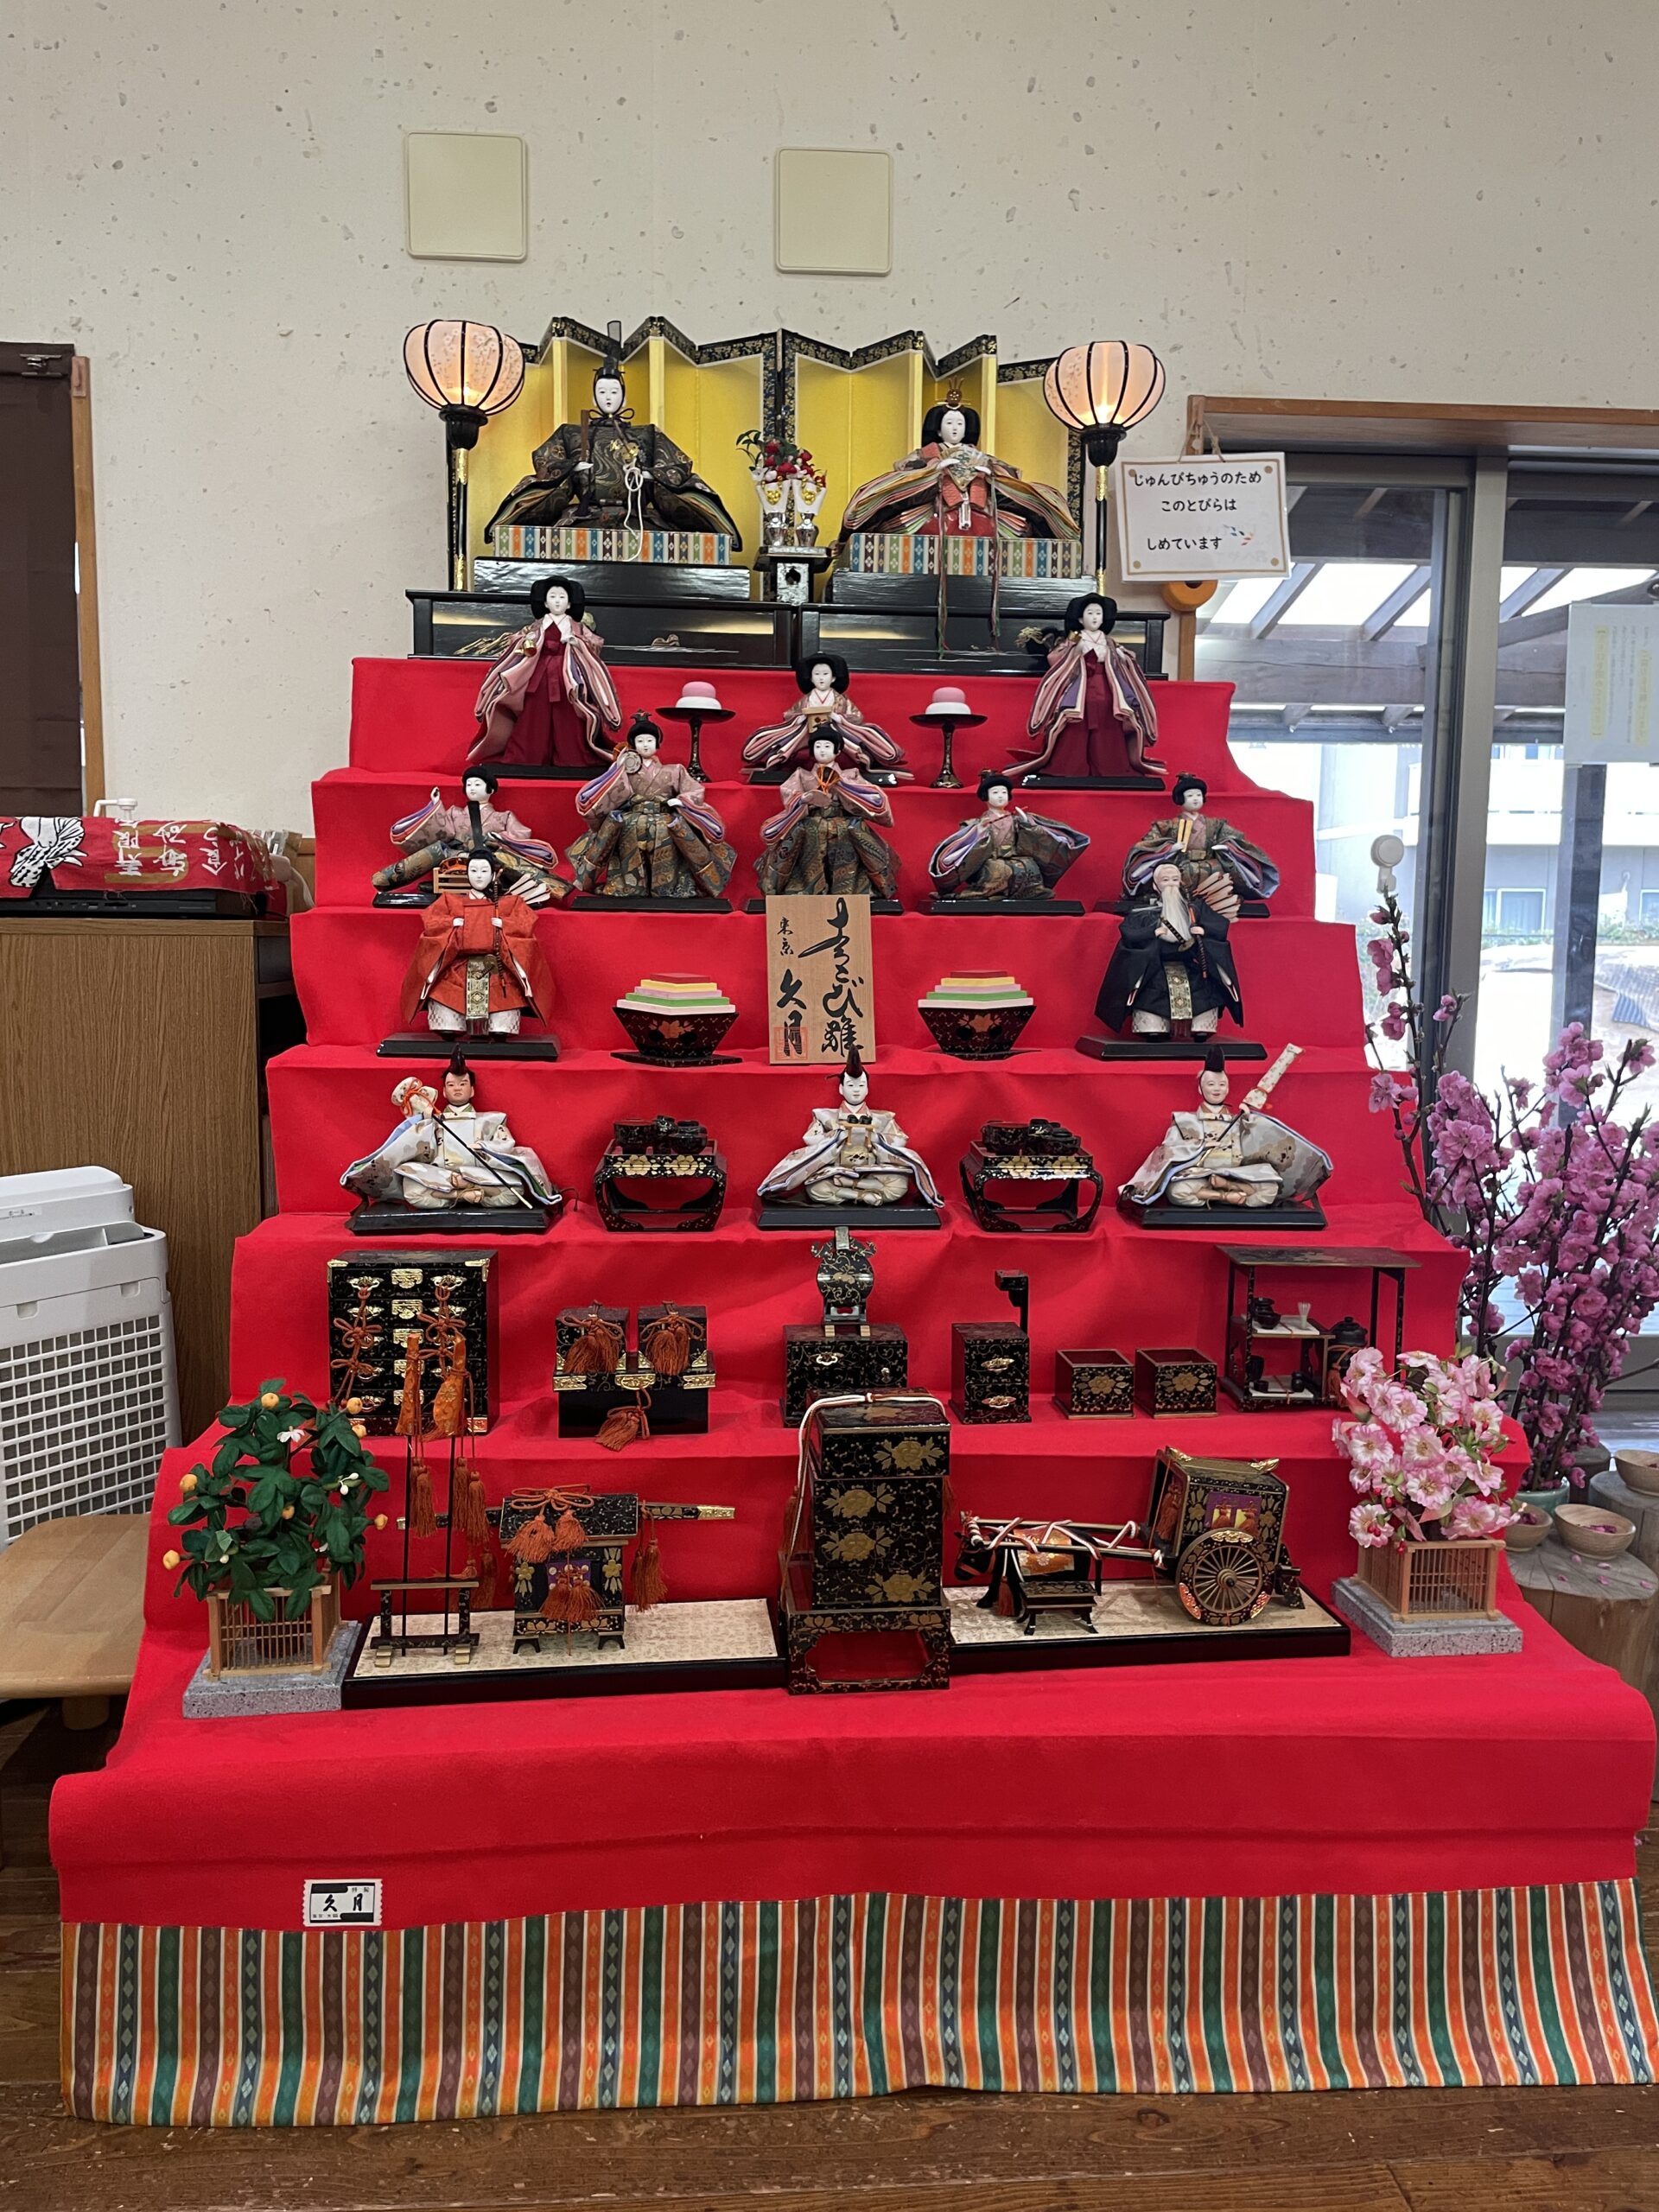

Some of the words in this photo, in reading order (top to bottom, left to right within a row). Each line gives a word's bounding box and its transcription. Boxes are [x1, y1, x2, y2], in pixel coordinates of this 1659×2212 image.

[1134, 471, 1262, 487] じゅんびちゅうのため
[1161, 498, 1237, 512] このとびらは
[1147, 537, 1223, 550] しめています
[199, 820, 227, 876] 食う
[777, 916, 794, 956] 東京
[777, 968, 807, 1056] 久月
[322, 1892, 364, 1912] 久月
